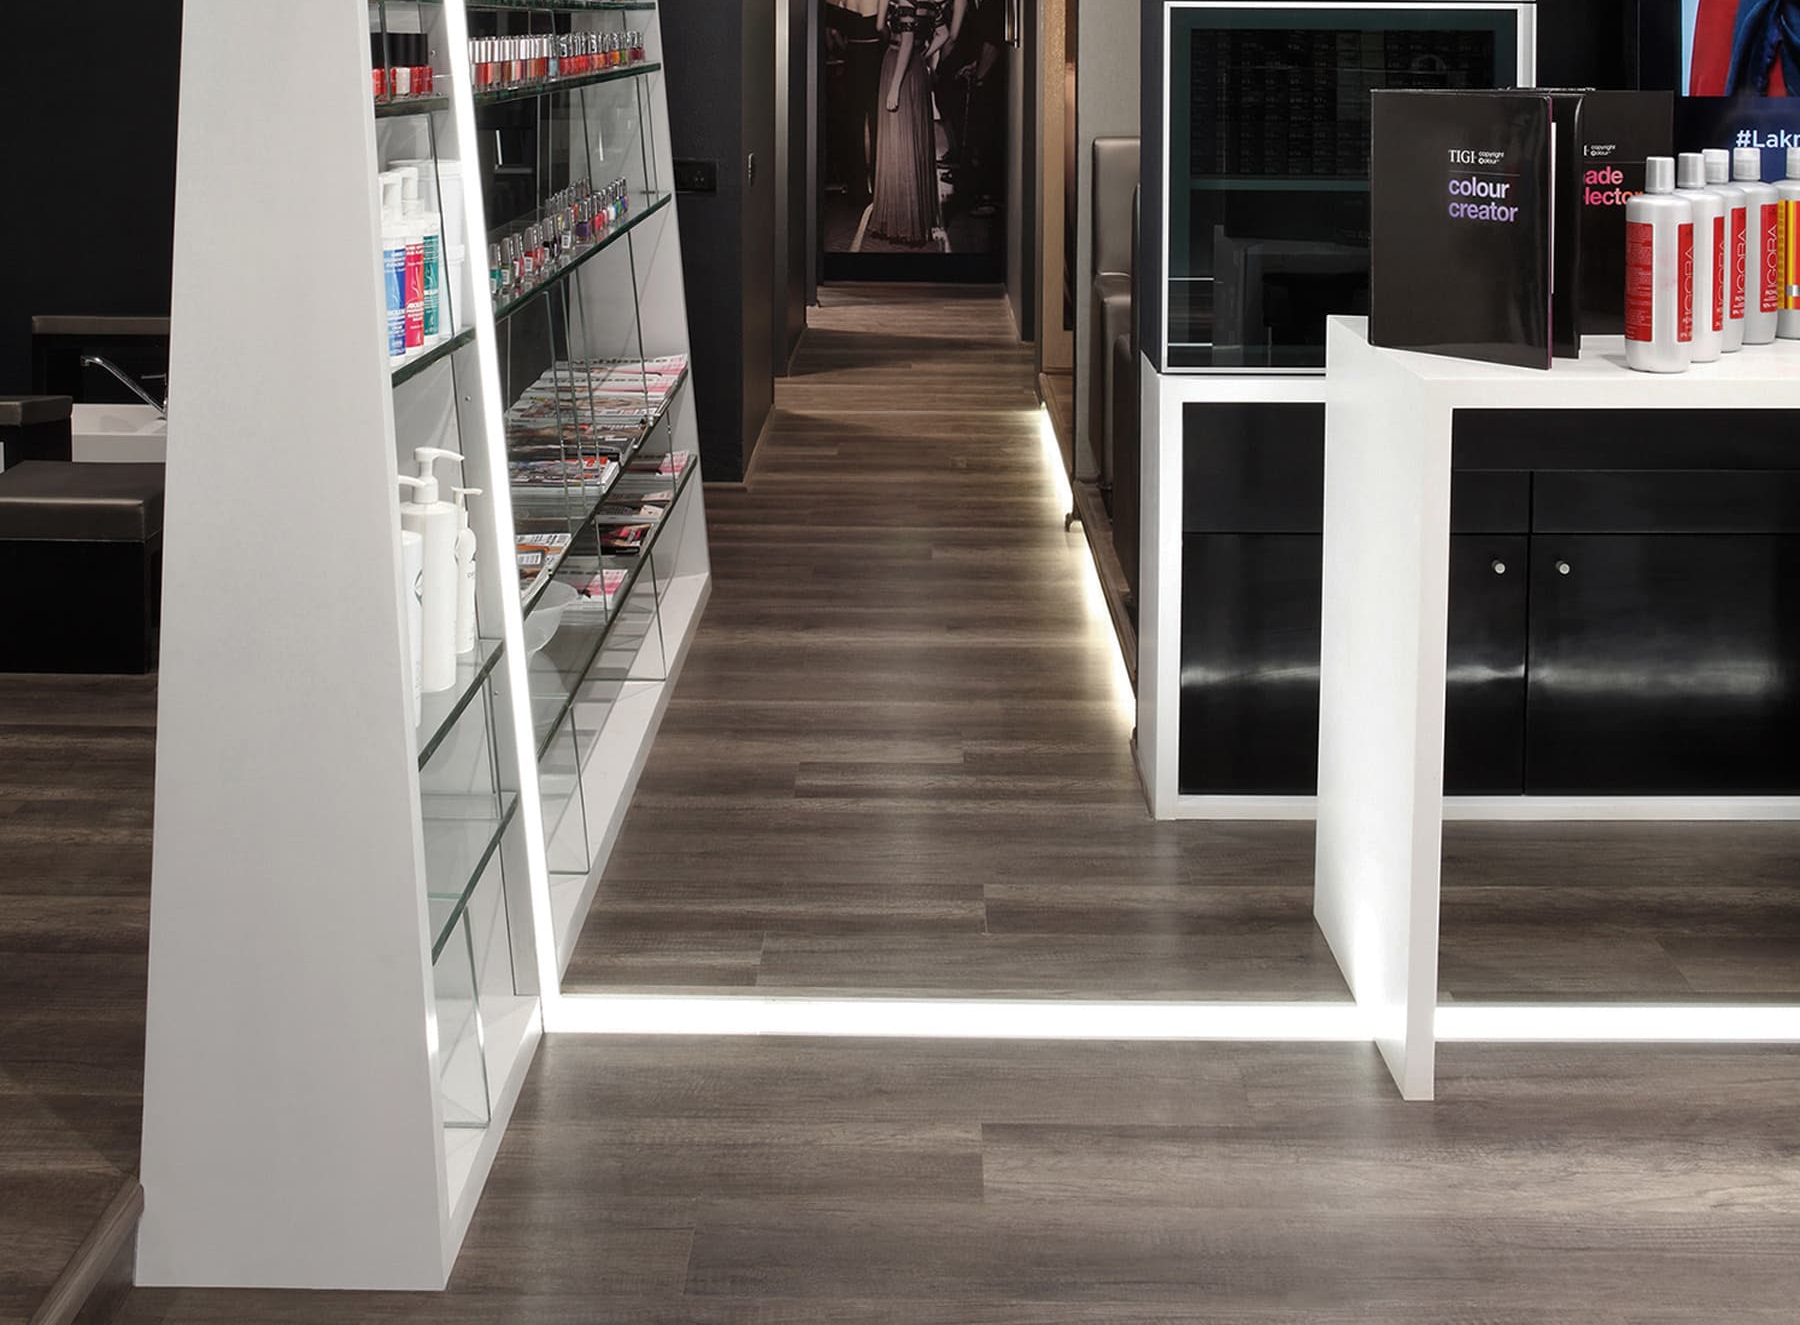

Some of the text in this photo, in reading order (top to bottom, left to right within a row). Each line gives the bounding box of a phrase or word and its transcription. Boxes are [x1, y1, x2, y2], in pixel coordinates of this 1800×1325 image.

[1447, 150, 1475, 164] TIGI
[1448, 176, 1510, 198] colour
[1448, 202, 1519, 222] creator
